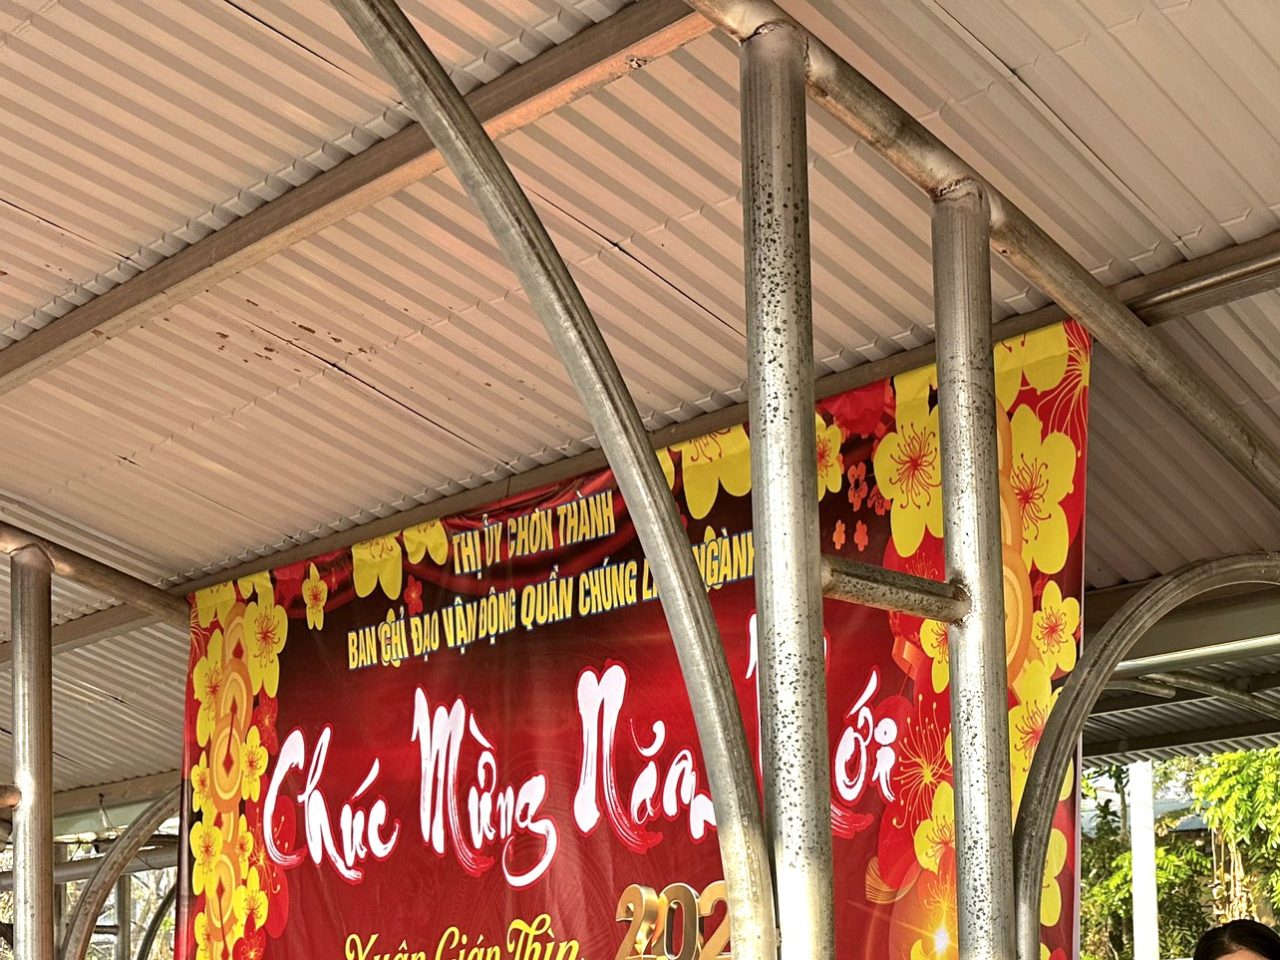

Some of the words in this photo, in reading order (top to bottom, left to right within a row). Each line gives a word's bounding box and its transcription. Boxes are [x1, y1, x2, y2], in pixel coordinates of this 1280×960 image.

[452, 530, 483, 580] THỊ
[507, 508, 554, 559] CHƠN
[556, 489, 616, 547] THÀNH
[347, 625, 379, 670] BAN
[379, 604, 409, 663] CHỈ
[410, 610, 440, 662] ĐẠO
[441, 596, 478, 655] VẬN
[478, 586, 516, 646] ĐỘNG
[578, 555, 637, 616] CHÚNG
[264, 724, 401, 883] Chúc
[410, 686, 558, 888] Mừng
